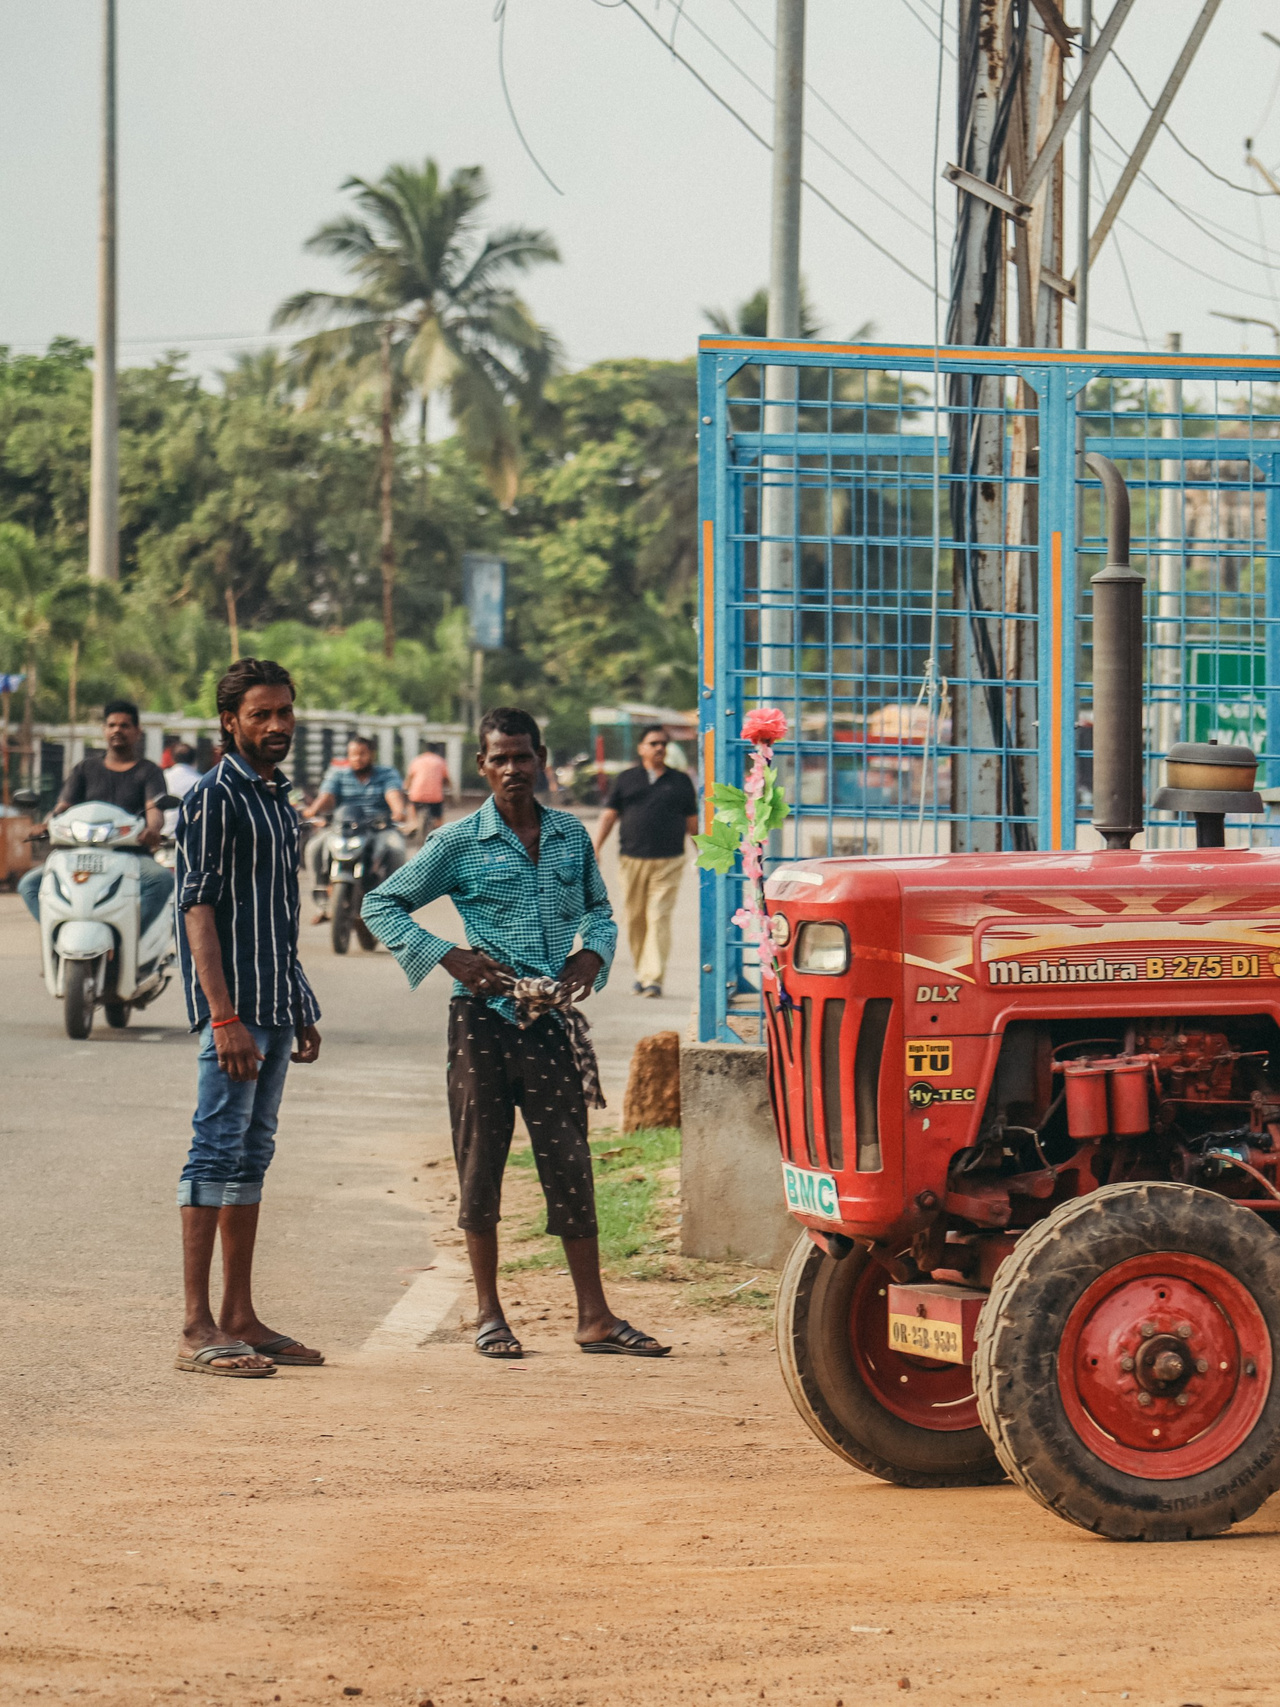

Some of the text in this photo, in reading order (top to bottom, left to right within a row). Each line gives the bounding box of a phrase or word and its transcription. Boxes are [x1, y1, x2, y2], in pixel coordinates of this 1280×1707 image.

[988, 957, 1138, 984] Mahindra
[1146, 957, 1166, 979] B
[1172, 955, 1223, 979] 275
[1230, 953, 1260, 978] DI
[915, 985, 962, 1003] DLX
[908, 1044, 950, 1053] High Torque
[908, 1054, 950, 1072] TU
[908, 1088, 976, 1104] Hy-TEC
[785, 1167, 836, 1216] BMC
